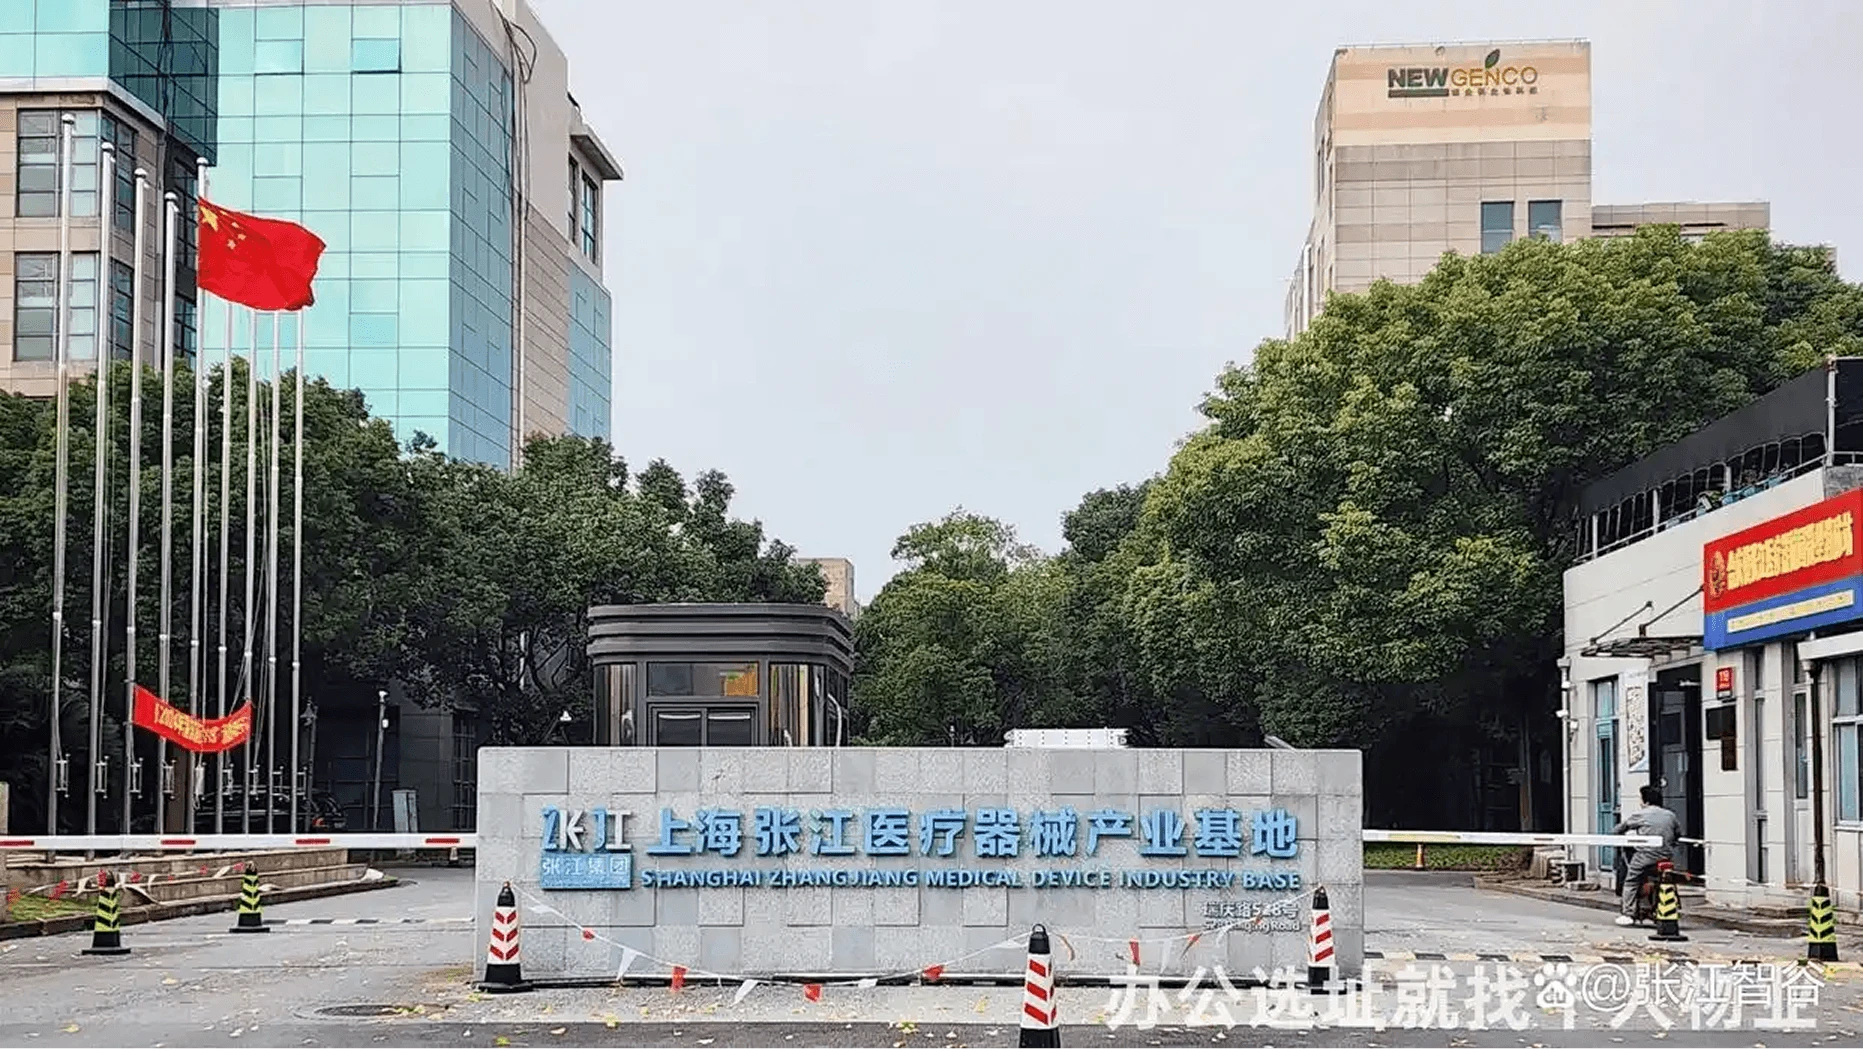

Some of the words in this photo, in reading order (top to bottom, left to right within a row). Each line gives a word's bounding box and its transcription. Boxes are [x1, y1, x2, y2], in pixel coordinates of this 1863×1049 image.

[646, 807, 1299, 858] 上海张江医疗器械产业基地
[542, 857, 628, 875] 张江集团
[641, 869, 762, 888] SHANGHAI
[769, 869, 918, 888] ZHANGJIANG
[925, 869, 1022, 889] MEDICAL
[1032, 869, 1110, 889] DEVICE
[1119, 869, 1235, 889] INDUSTRY
[1242, 870, 1300, 890] BASE
